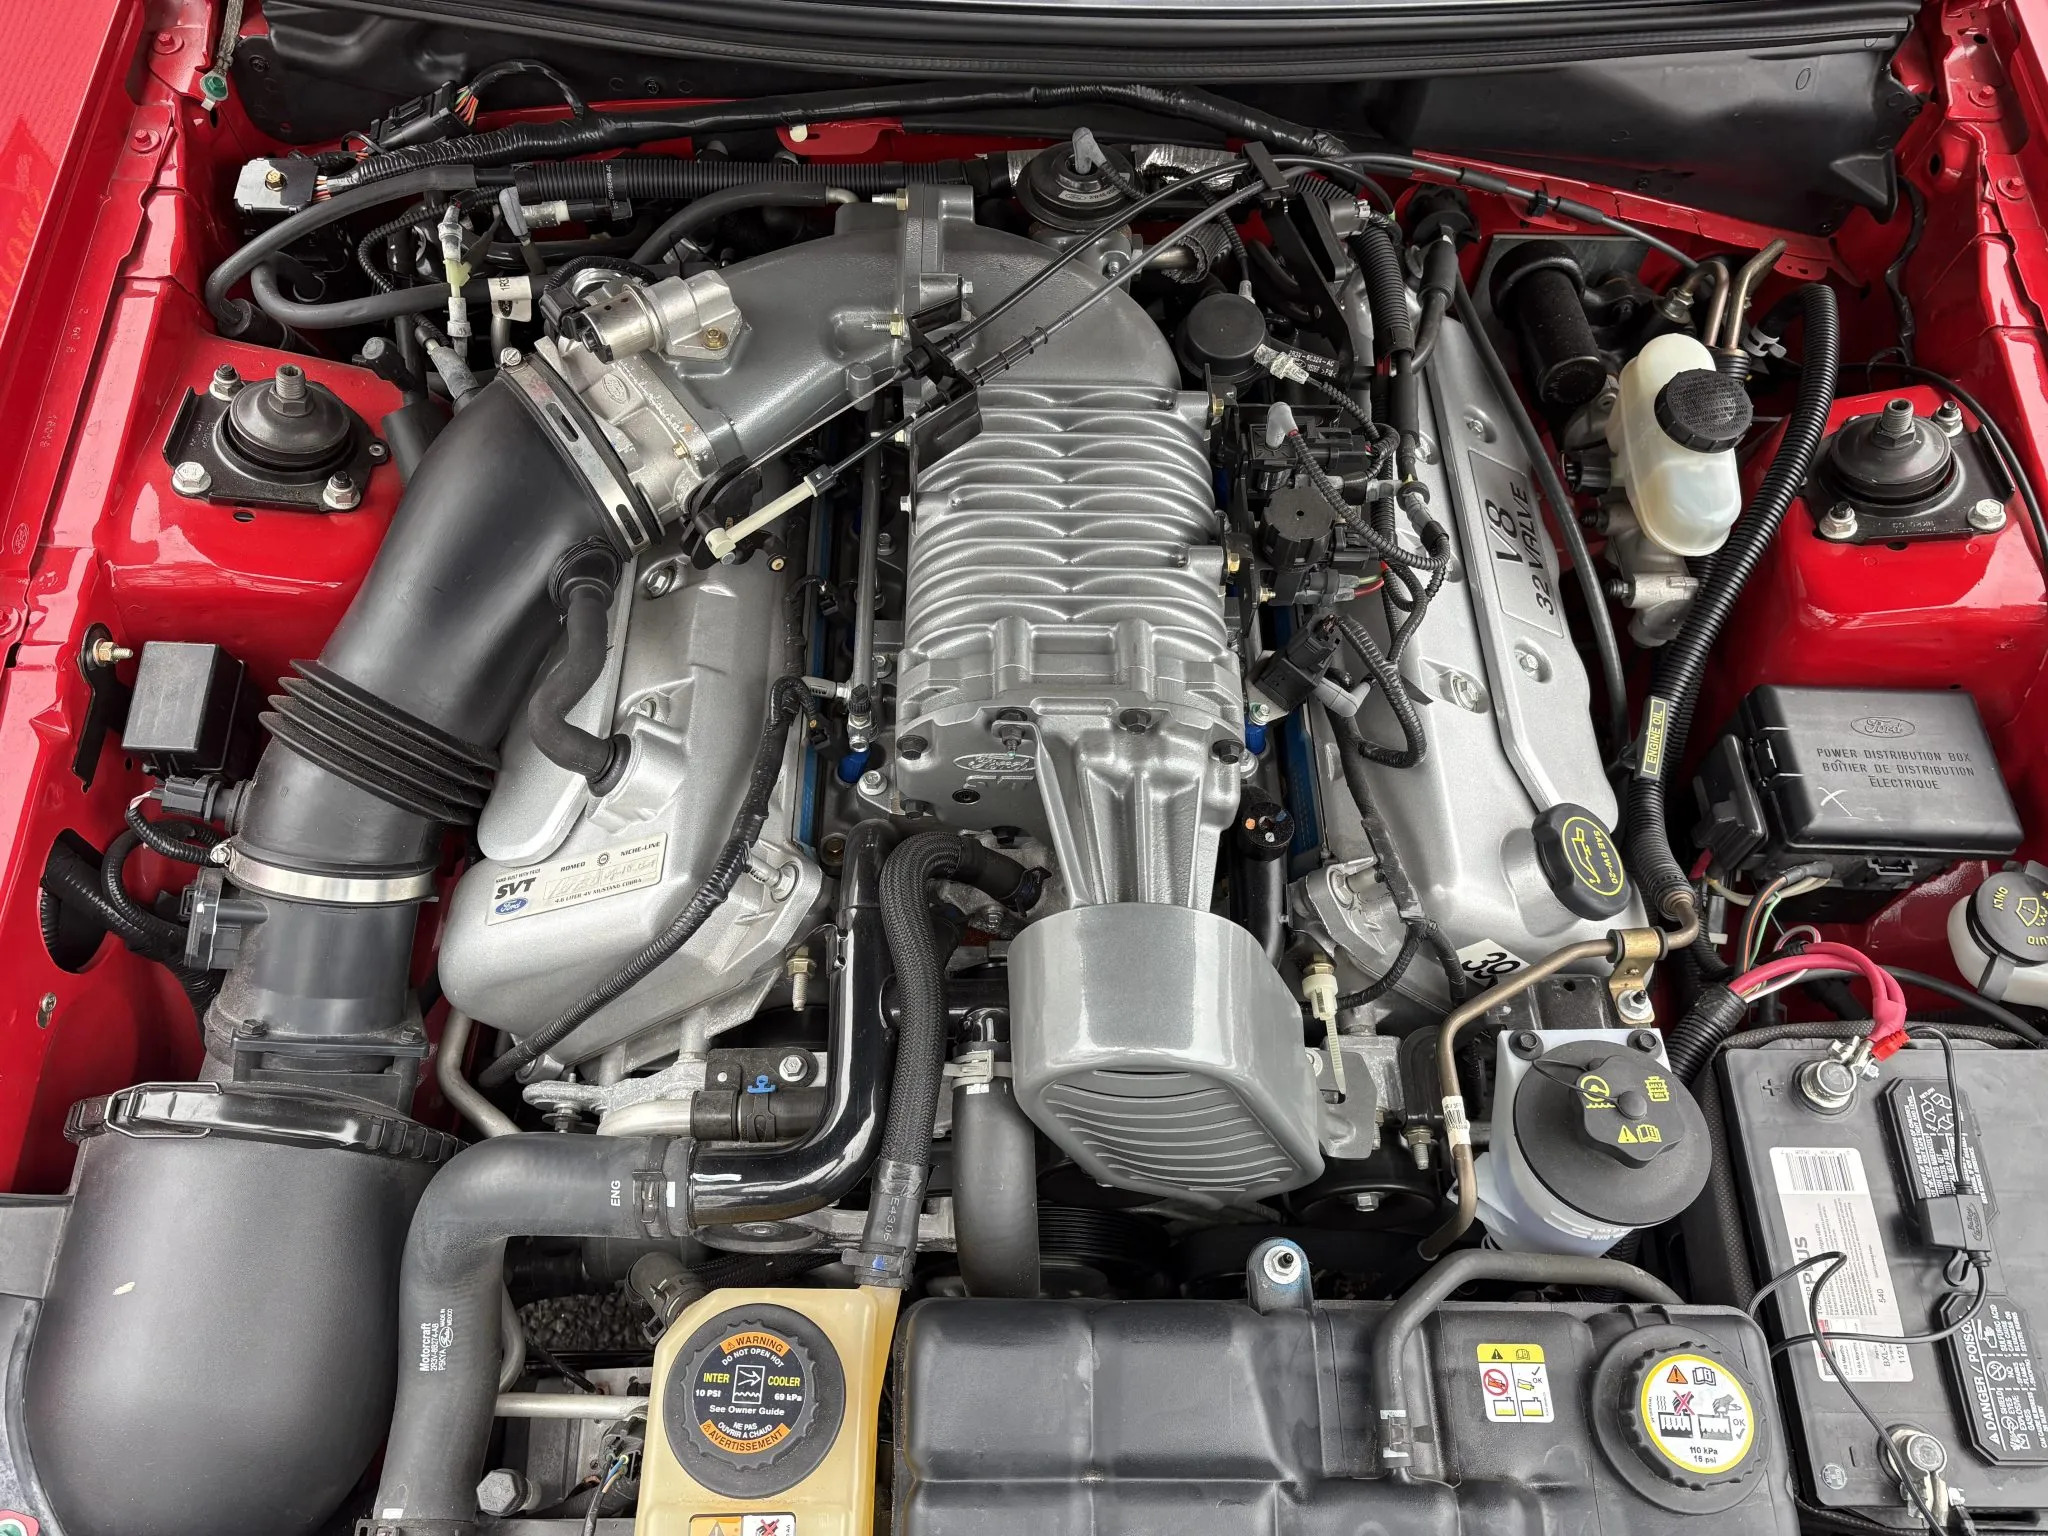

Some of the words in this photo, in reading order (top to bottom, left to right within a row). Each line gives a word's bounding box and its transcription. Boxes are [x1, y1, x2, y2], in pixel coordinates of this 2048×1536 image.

[1484, 499, 1523, 562] V8
[1509, 482, 1543, 568] VALVE
[1531, 574, 1554, 614] 32
[1652, 710, 1662, 724] OIL
[1862, 718, 1905, 734] Ford
[1646, 726, 1660, 763] ENGINE
[963, 754, 1032, 772] Ford
[1817, 748, 1858, 759] POWER
[1864, 749, 1942, 760] DISTRIBUTION
[1949, 752, 1972, 762] BOX
[1823, 760, 1868, 772] BOÎTIER
[1875, 764, 1891, 773] DE
[1897, 765, 1975, 776] DISTRIBUTION
[1593, 830, 1605, 848] SAE
[560, 861, 585, 872] ROMEO
[621, 841, 660, 856] NICHE-LINE
[495, 876, 536, 899] SVT
[499, 897, 522, 914] Ford
[1993, 886, 2008, 910] ONLY
[2027, 935, 2048, 944] UID
[1904, 1105, 1914, 1128] CHILDREN
[1912, 1137, 1920, 1153] REACH
[1942, 1148, 1950, 1159] FAST
[1920, 1165, 1925, 1173] OF
[610, 1180, 621, 1207] ENG
[1937, 1180, 1945, 1194] FLUSH
[1876, 1289, 1885, 1303] 540
[1990, 1305, 1999, 1319] ACID
[2002, 1321, 2010, 1338] CAUSE
[2012, 1313, 2020, 1330] BURNS
[736, 1336, 783, 1353] WARNING
[1958, 1316, 1979, 1362] POISO
[1994, 1322, 2007, 1351] SULFURIC
[2008, 1322, 2020, 1351] BLINDNESS
[2017, 1331, 2026, 1351] SEVERE
[419, 1322, 430, 1371] Motorcraft
[1879, 1343, 1890, 1367] BXL-5
[722, 1356, 733, 1366] DO
[734, 1348, 748, 1358] NOT
[751, 1348, 770, 1358] OPEN
[771, 1355, 784, 1368] HOT
[704, 1373, 730, 1383] INTER
[768, 1376, 800, 1386] COOLER
[2006, 1367, 2014, 1377] NO
[710, 1405, 726, 1413] See
[728, 1406, 756, 1414] Owner
[759, 1407, 784, 1415] Guide
[1973, 1377, 1997, 1430] DANGER
[1996, 1391, 2007, 1414] SHIELD
[2005, 1398, 2015, 1414] EYES
[2027, 1392, 2039, 1419] BLINDNESS
[2012, 1396, 2026, 1430] EXPLOSIVE
[2024, 1410, 2034, 1430] GASES
[718, 1422, 741, 1437] OUVRIR
[749, 1425, 772, 1438] CHAUD
[2035, 1420, 2043, 1436] CAUSE
[709, 1429, 783, 1451] AVERTISSEMENT
[1703, 1447, 1718, 1455] kPa
